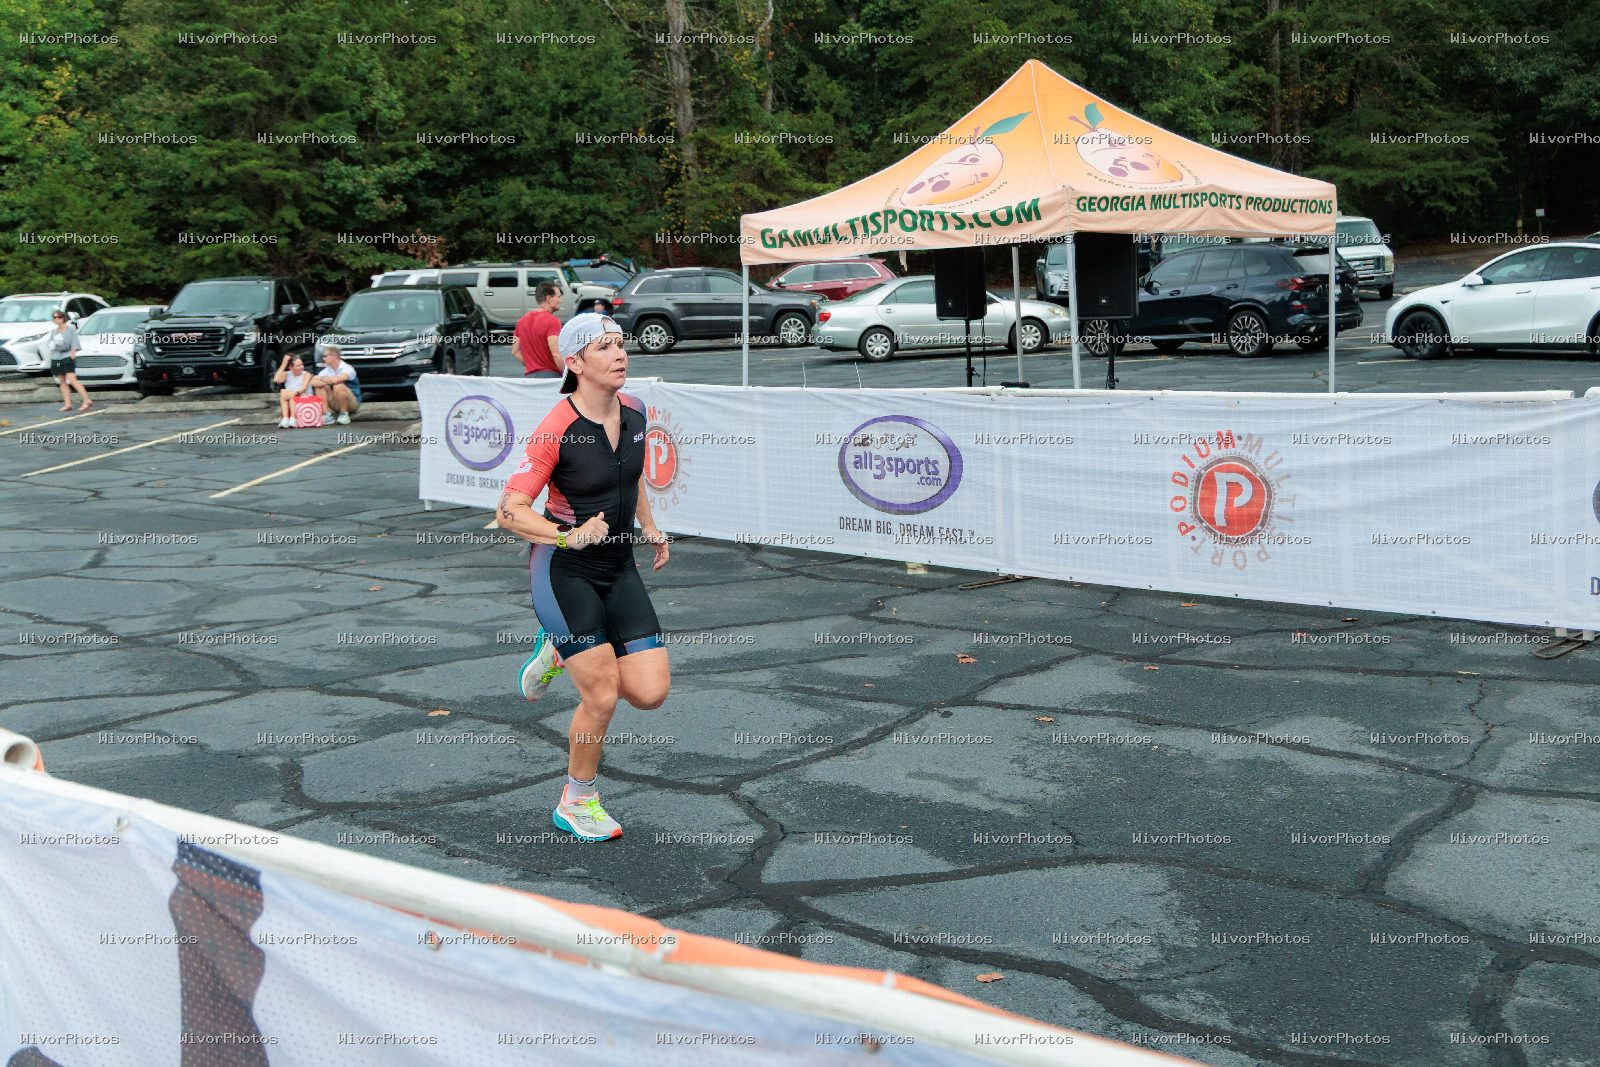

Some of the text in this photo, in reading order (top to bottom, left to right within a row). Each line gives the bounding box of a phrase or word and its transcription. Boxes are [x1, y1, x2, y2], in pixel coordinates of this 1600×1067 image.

[1076, 191, 1332, 214] GEORGIA MULTISPORTS PRODUCTIONS
[760, 198, 1042, 248] GAMULTISPORTS.COM
[853, 451, 941, 480] all3sports
[917, 476, 943, 487] .com
[1214, 471, 1253, 527] P
[839, 516, 872, 533] DREAM
[899, 522, 934, 538] DREAM
